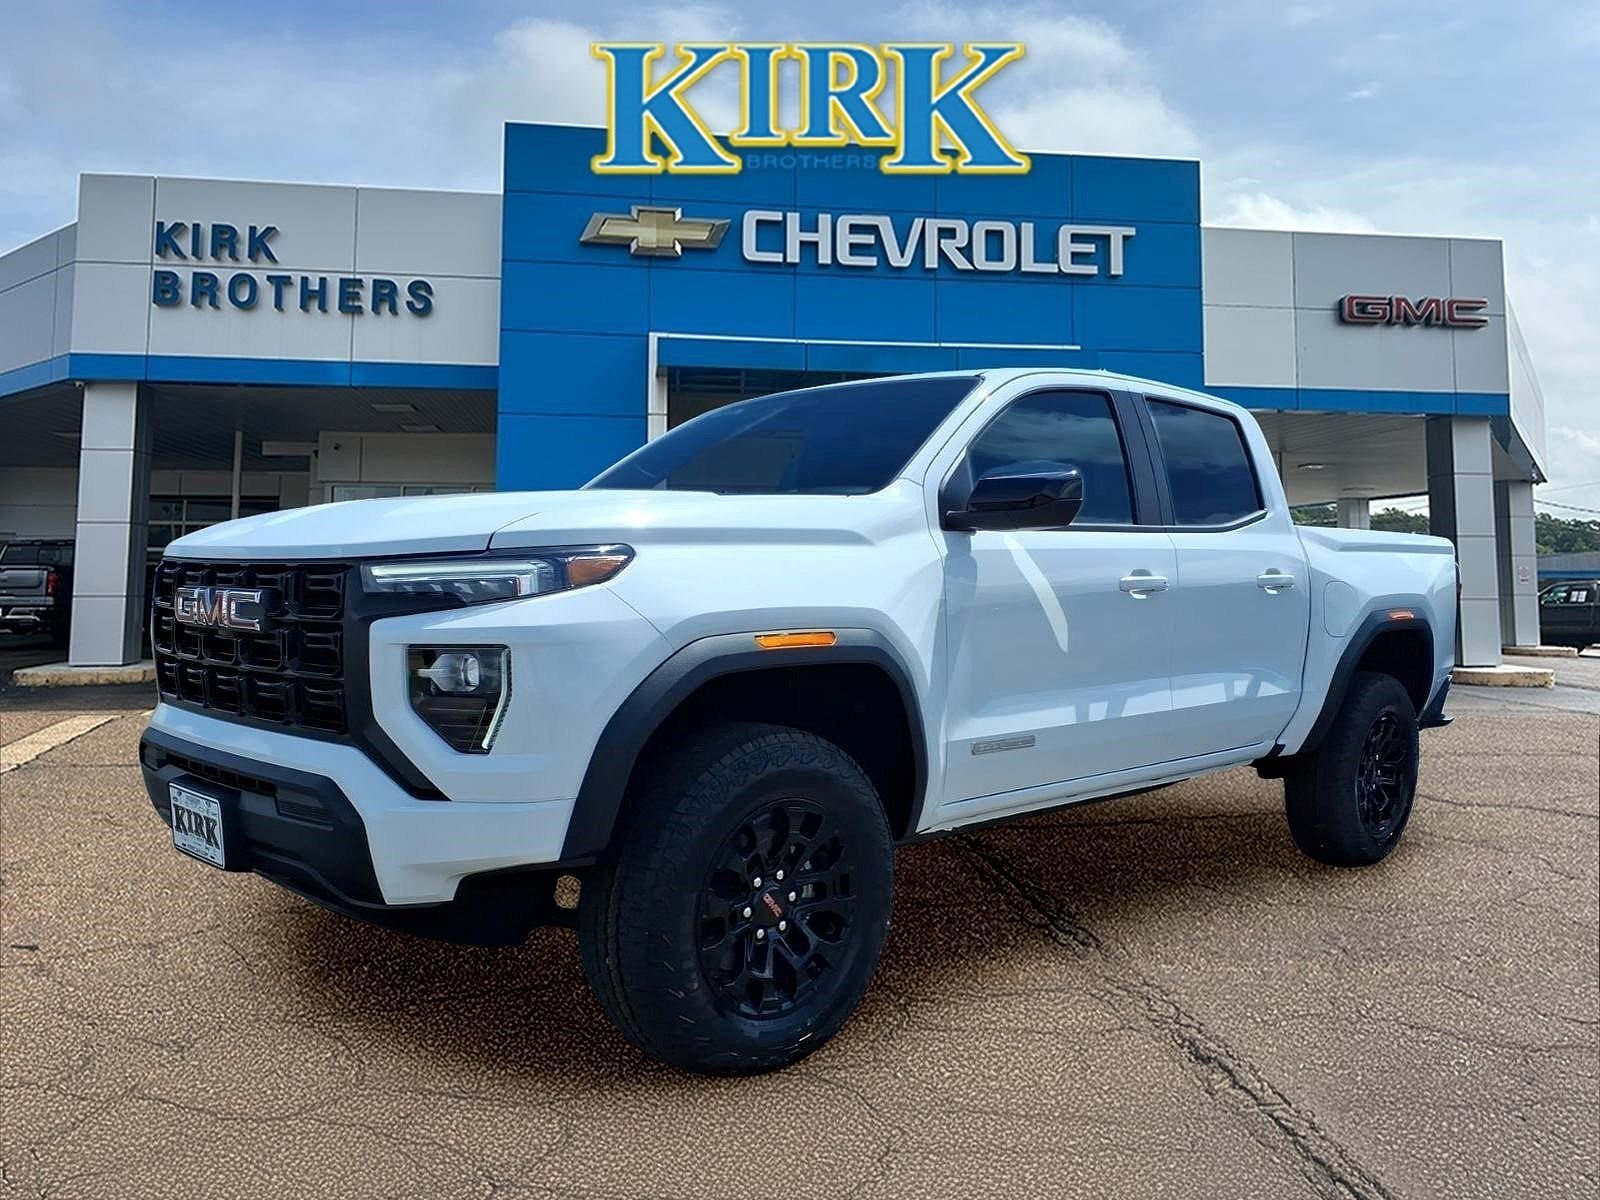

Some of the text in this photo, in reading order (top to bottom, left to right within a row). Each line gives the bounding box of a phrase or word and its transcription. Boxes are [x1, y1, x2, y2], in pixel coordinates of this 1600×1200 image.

[155, 220, 280, 263] KIRK
[742, 209, 1136, 276] CHEVROLET
[152, 269, 434, 317] BROTHERS
[1340, 293, 1489, 328] GMC
[174, 587, 263, 632] GMC
[173, 803, 221, 850] KIRK
